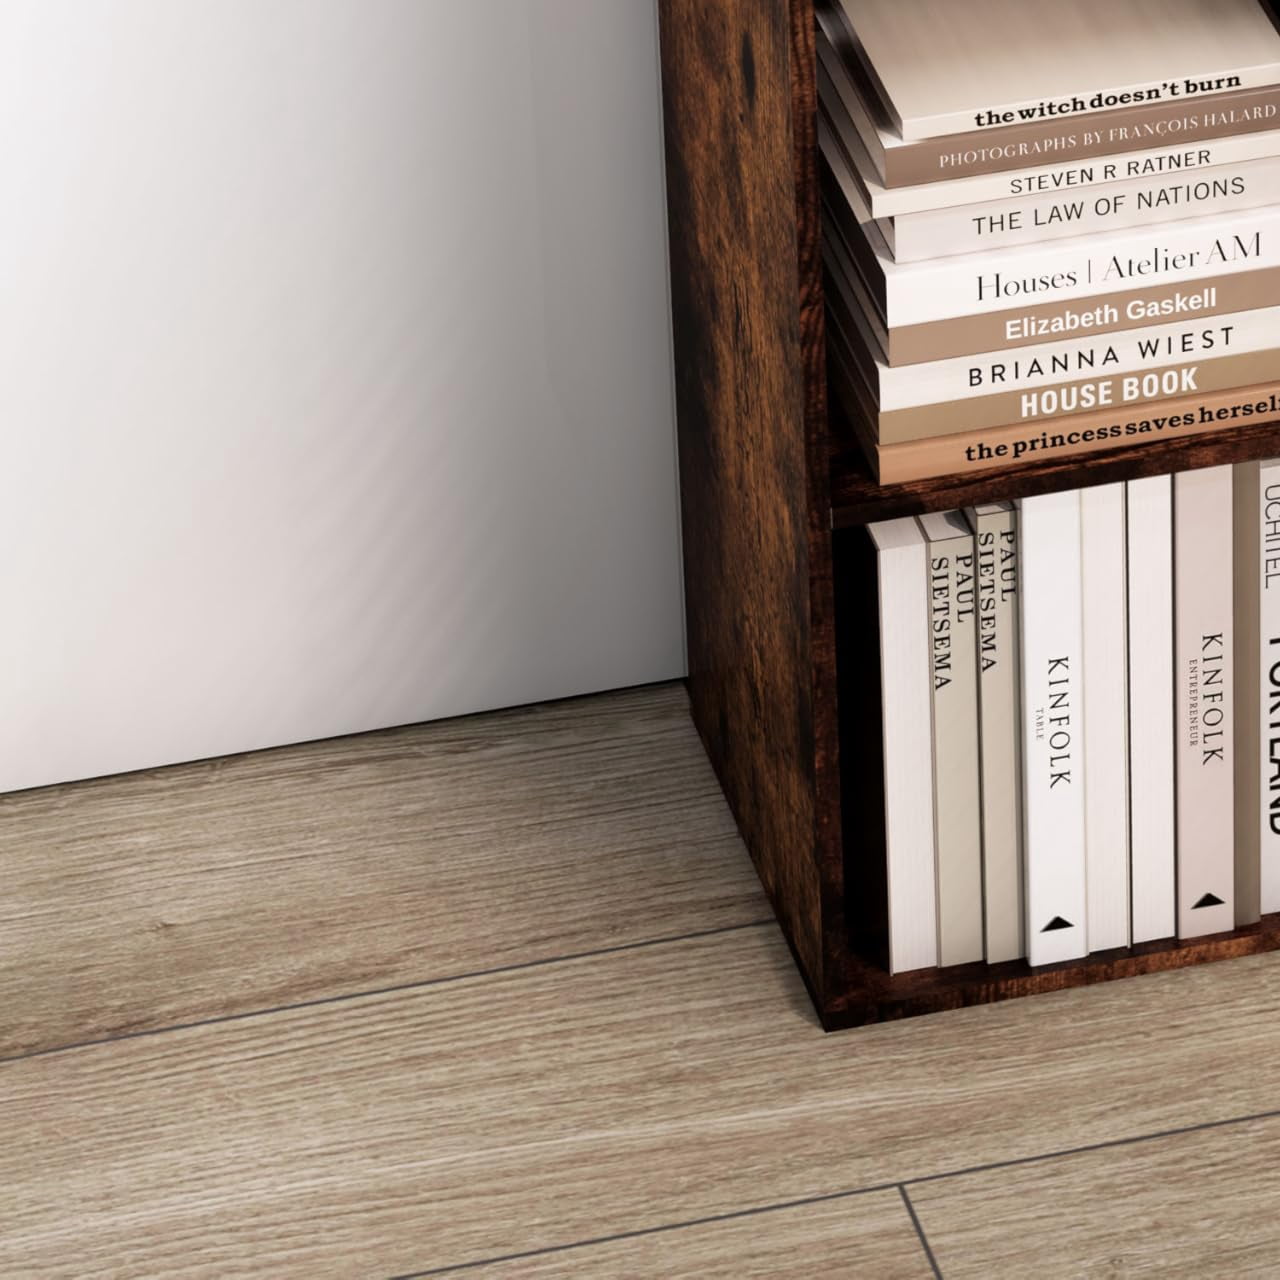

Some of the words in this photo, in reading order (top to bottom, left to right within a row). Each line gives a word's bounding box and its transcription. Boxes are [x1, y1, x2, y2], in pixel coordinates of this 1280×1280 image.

[974, 108, 1015, 128] the
[1018, 96, 1086, 124] witch
[1184, 73, 1242, 96] burn
[938, 133, 1077, 169] PHOTOGRAPHS
[1081, 128, 1103, 144] BY
[1108, 116, 1199, 144] FRANÇOIS
[1203, 103, 1278, 128] HALARD
[1009, 166, 1094, 195] STEVEN
[1103, 163, 1118, 180] R
[1126, 149, 1212, 176] RATNER
[972, 210, 1023, 236] THE
[1034, 200, 1085, 227] LAW
[1094, 194, 1126, 218] OF
[1136, 176, 1246, 211] NATIONS
[976, 270, 1078, 302] Houses
[1103, 246, 1200, 282] Atelier
[1204, 230, 1263, 265] AM
[1005, 303, 1119, 341] Elizabeth
[1126, 286, 1217, 322] Gaskell
[968, 345, 1120, 387] BRIANNA
[1137, 325, 1235, 359] WIEST
[1020, 380, 1113, 418] HOUSE
[1122, 366, 1199, 402] BOOK
[964, 442, 1008, 462] the
[1012, 423, 1122, 459] princess
[1124, 413, 1196, 438] saves
[955, 553, 977, 624] PAUL
[999, 529, 1018, 604] PAUL
[931, 556, 953, 691] SIETSEMA
[978, 531, 998, 674] SIETSEMA
[1034, 706, 1045, 742] TABLE
[1047, 655, 1072, 790] KINFOLK
[1188, 658, 1199, 749] ENTREPRENEUR
[1201, 632, 1225, 766] KINFOLK
